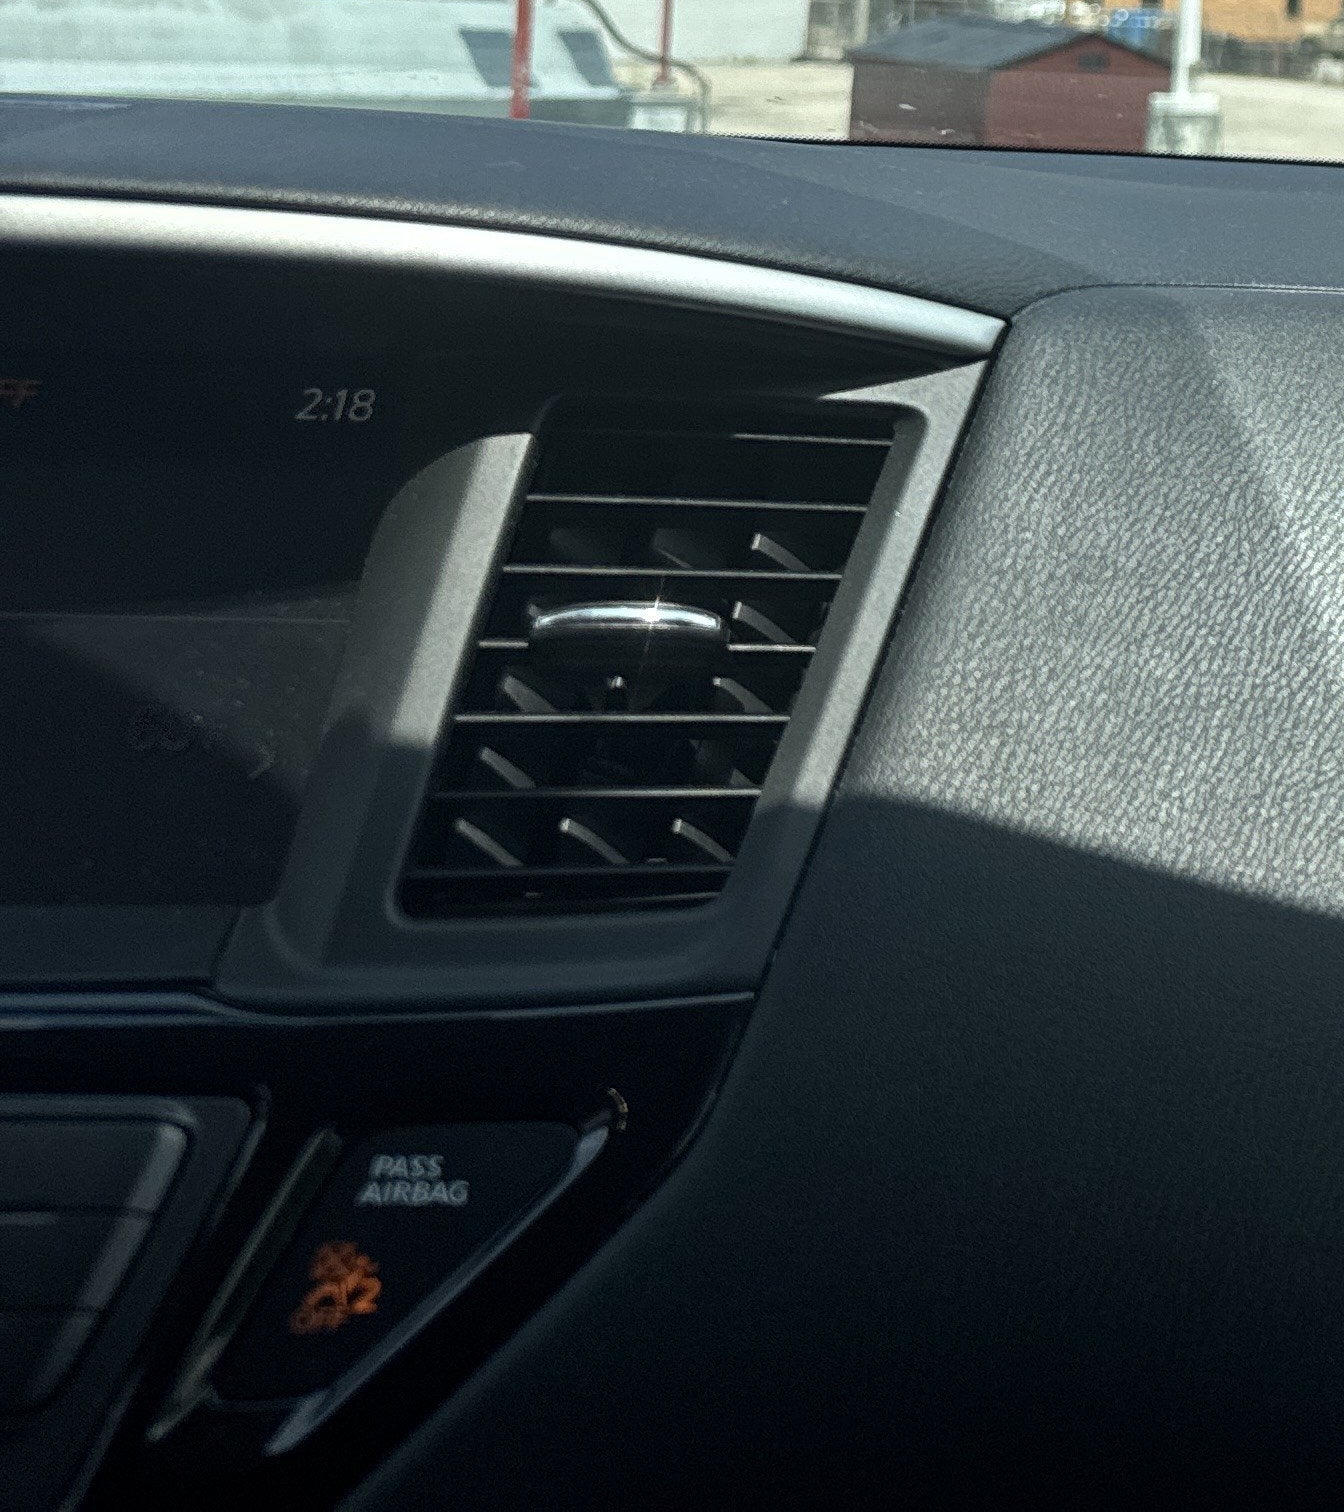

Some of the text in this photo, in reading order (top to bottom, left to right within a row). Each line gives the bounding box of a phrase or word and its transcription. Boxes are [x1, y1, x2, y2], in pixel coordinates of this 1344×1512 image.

[294, 388, 376, 421] 2:18
[370, 1153, 444, 1178] PASS
[358, 1180, 470, 1206] AIRBAG
